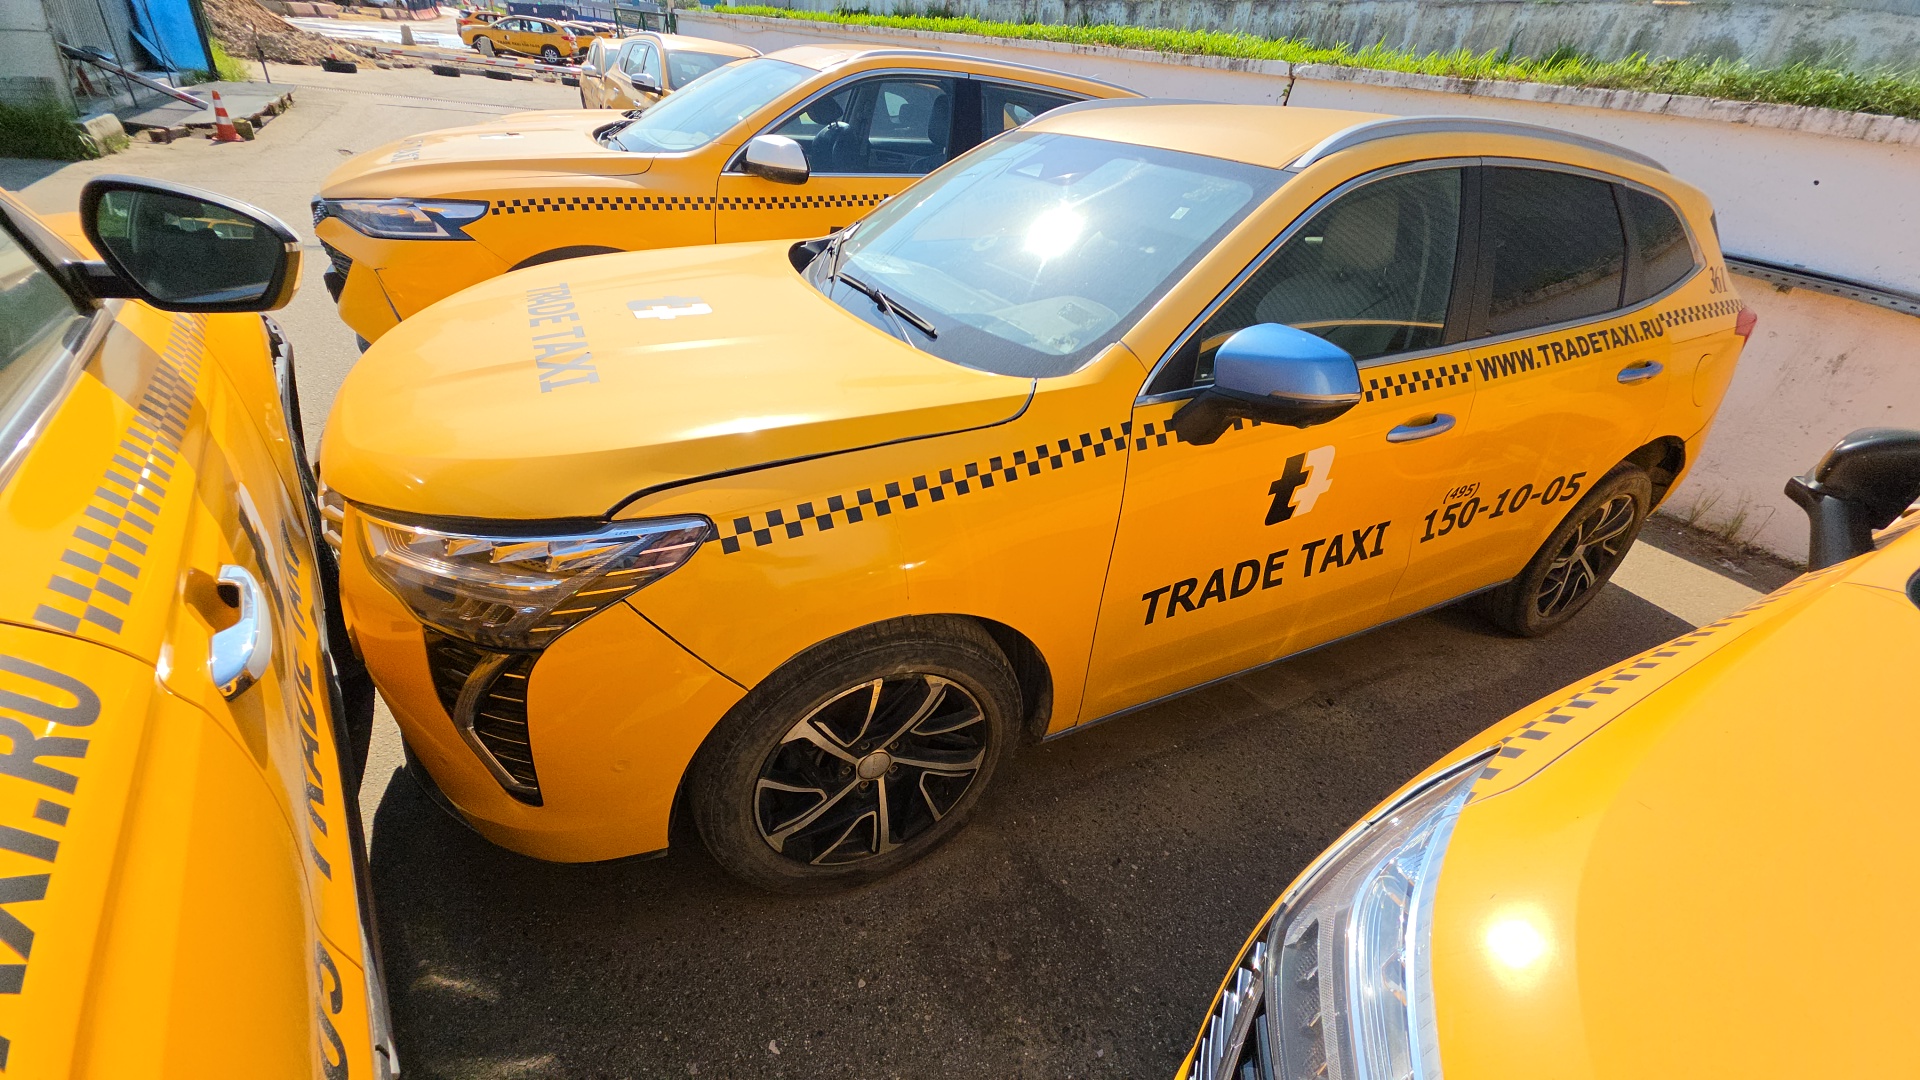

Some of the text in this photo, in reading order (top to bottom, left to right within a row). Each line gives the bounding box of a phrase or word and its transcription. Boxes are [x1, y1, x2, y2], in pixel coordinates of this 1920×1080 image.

[1709, 266, 1728, 294] 361
[526, 282, 600, 394] TRADE TAXI
[1476, 317, 1664, 382] WWW.TRADETAXI.RU
[1419, 471, 1588, 544] 150-10-05
[1442, 481, 1481, 505] (495)
[1141, 520, 1391, 626] TRADE TAXI
